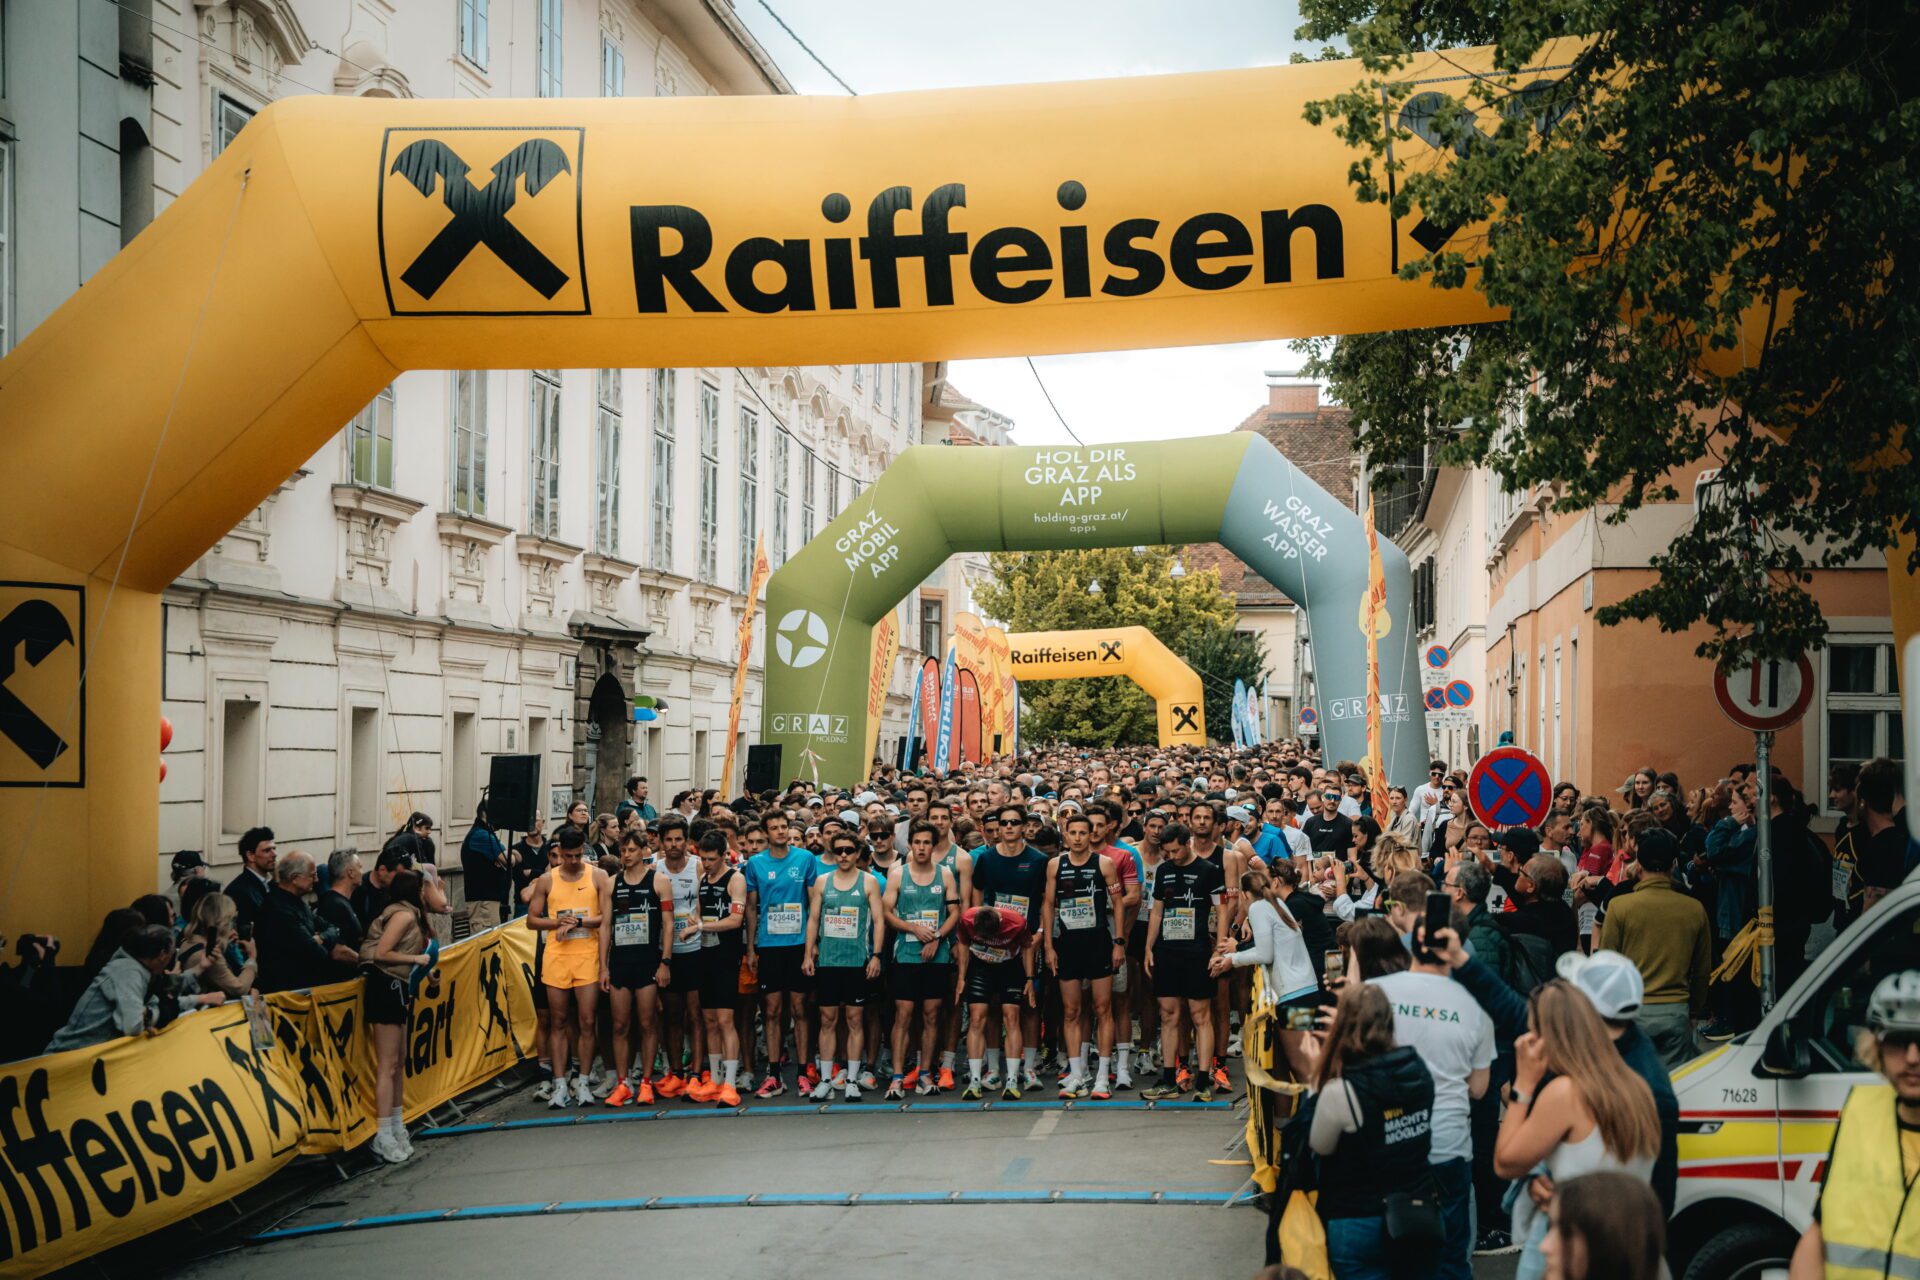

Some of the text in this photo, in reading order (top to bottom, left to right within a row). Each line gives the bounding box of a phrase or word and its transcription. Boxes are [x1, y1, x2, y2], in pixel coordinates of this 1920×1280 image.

[630, 180, 1344, 314] Raiffeisen
[1035, 448, 1127, 465] HOL DIR
[1024, 463, 1137, 485] GRAZ ALS
[1059, 486, 1102, 506] APP
[1033, 508, 1129, 525] holding-graz.at/
[1286, 496, 1335, 539] GRAZ
[835, 509, 883, 553] GRAZ
[1069, 525, 1097, 534] apps
[1263, 499, 1328, 562] WASSER
[844, 522, 900, 573] MOBIL
[1262, 532, 1299, 559] APP
[870, 545, 899, 579] APP
[1010, 647, 1098, 664] Raiffeisen
[772, 715, 845, 734] GRAZ
[816, 735, 848, 744] HOLDING
[773, 913, 796, 922] 2364B
[1066, 907, 1089, 918] 783C
[620, 923, 642, 933] 783A
[1722, 1088, 1758, 1103] 71628
